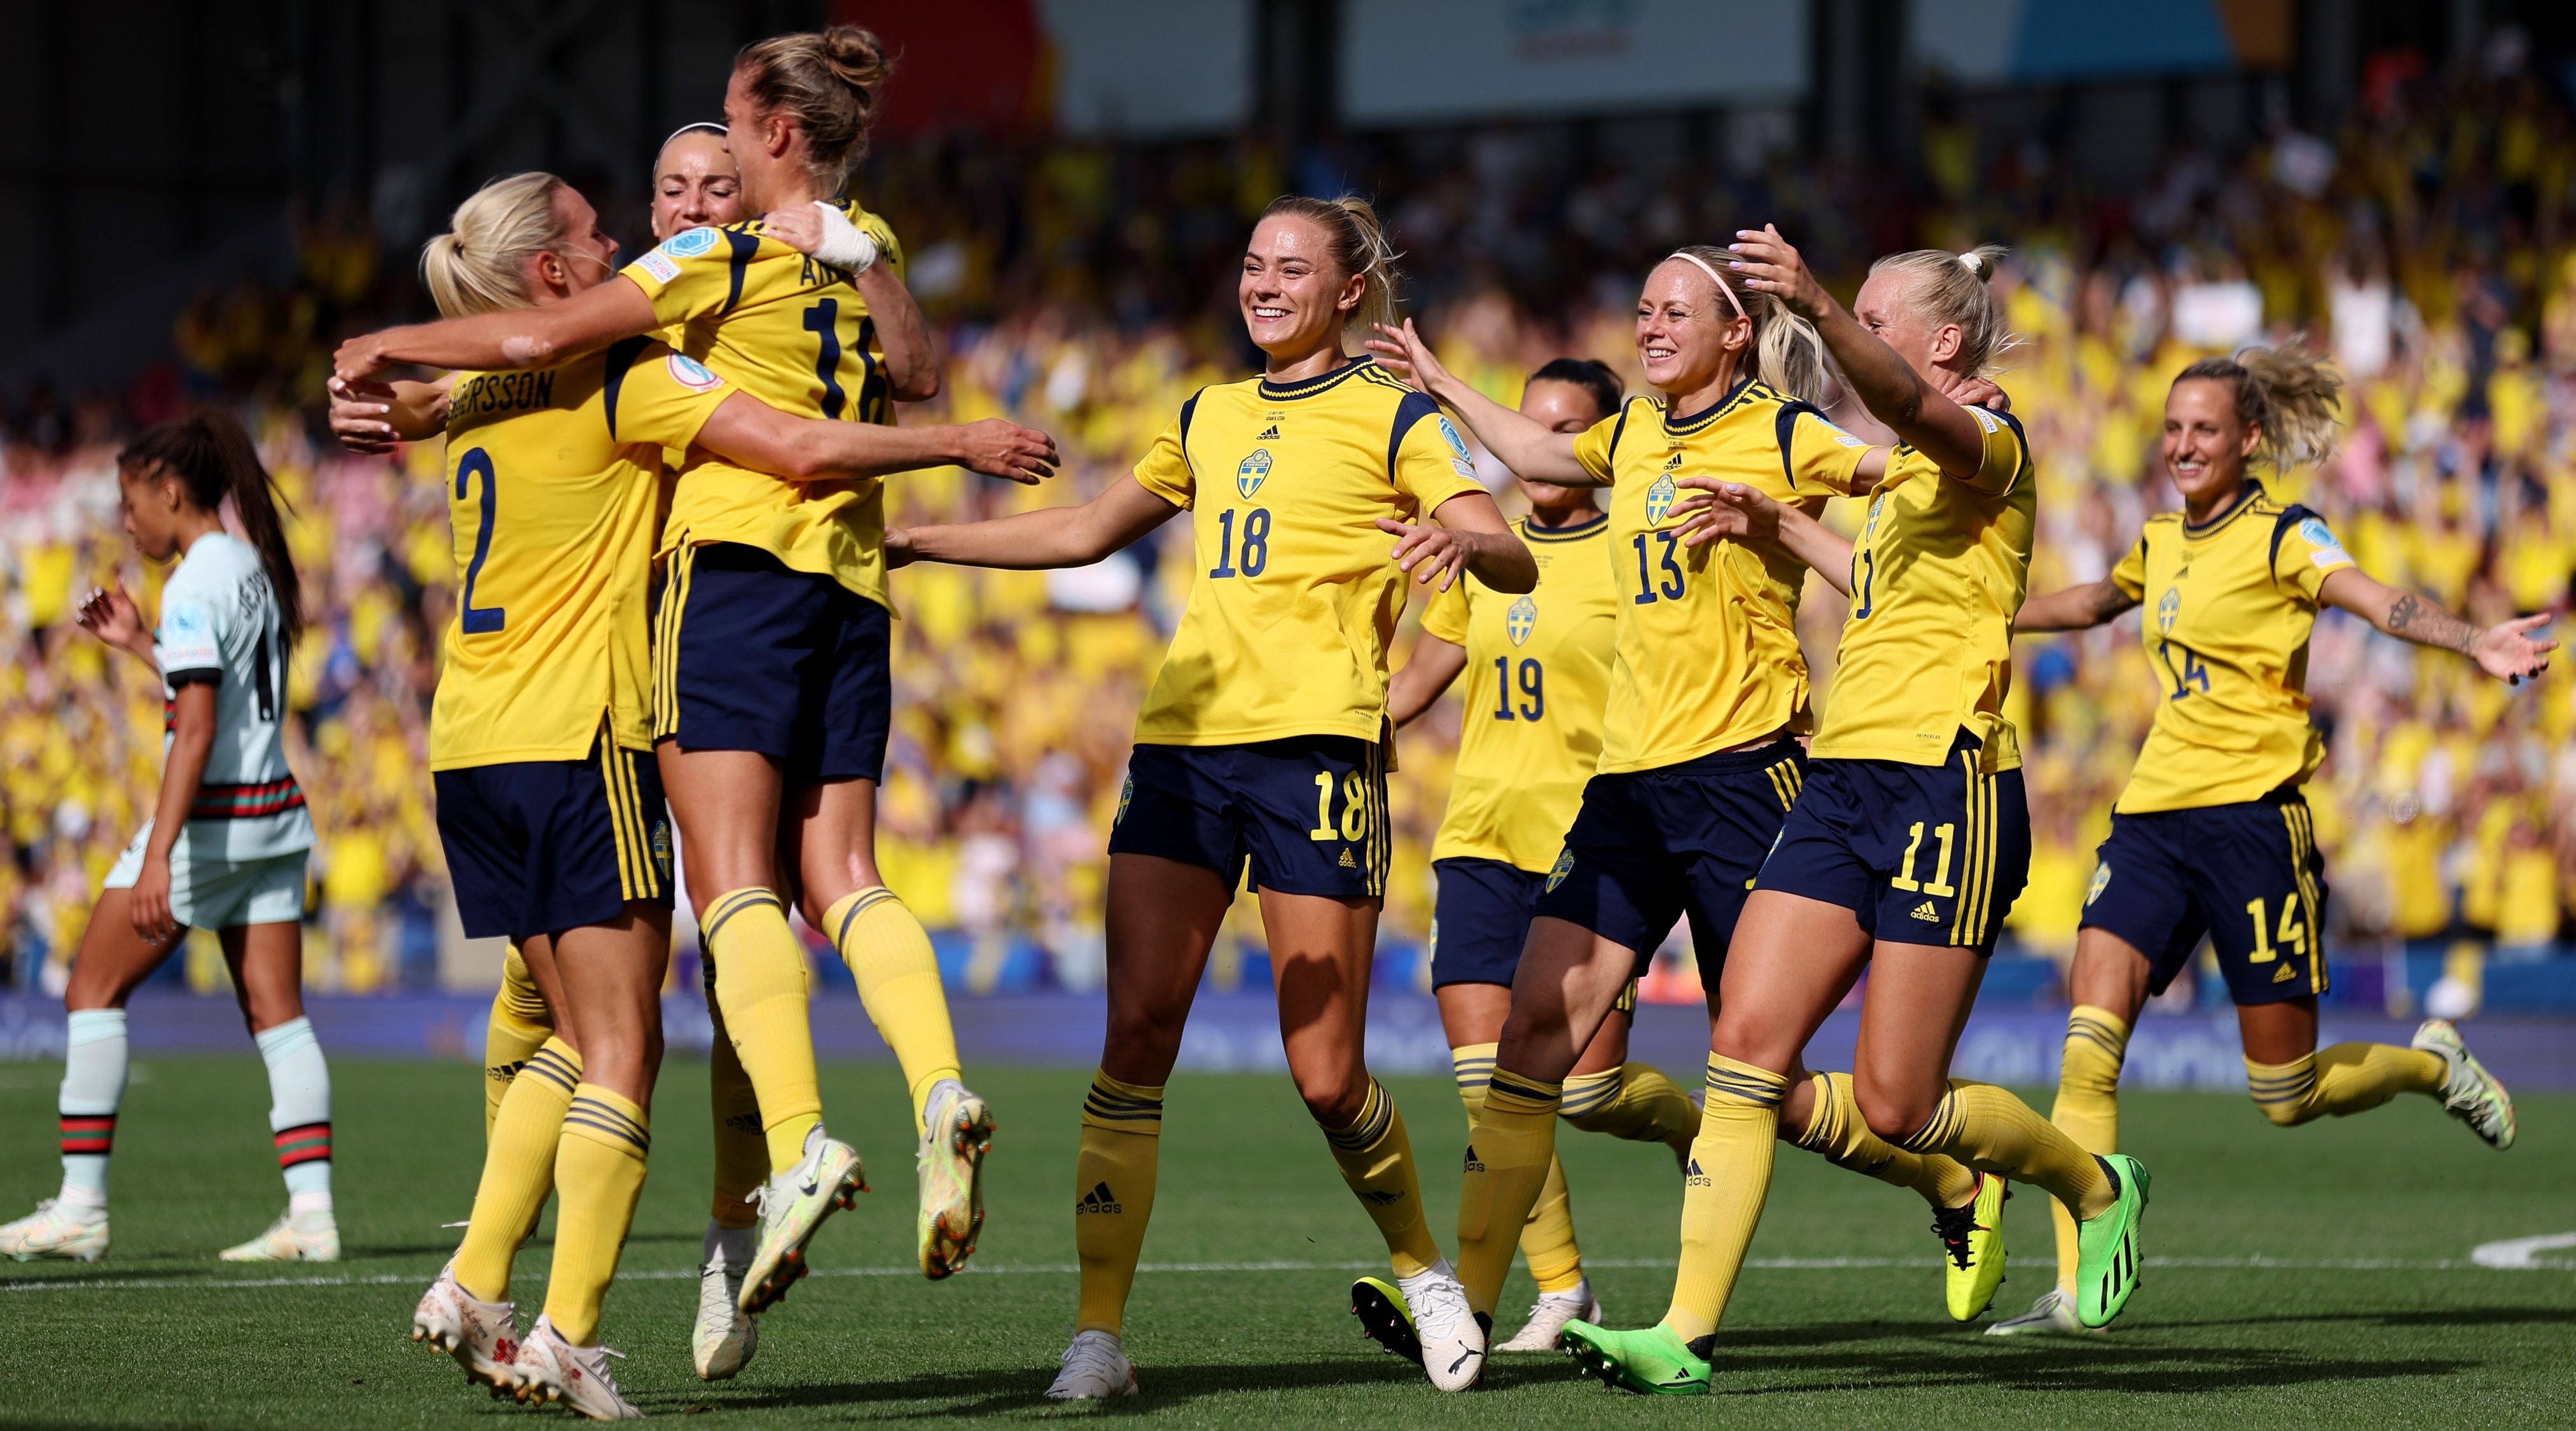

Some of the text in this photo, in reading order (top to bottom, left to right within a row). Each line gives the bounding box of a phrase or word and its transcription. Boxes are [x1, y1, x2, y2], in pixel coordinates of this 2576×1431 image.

[455, 447, 505, 634] 2
[1209, 508, 1271, 579] 18
[1633, 530, 1685, 605] 13
[1495, 656, 1544, 722] 19
[2158, 637, 2210, 702] 14
[1310, 770, 1366, 841] 18
[1338, 860, 1357, 868] adidas
[1892, 822, 1955, 897] 11
[1910, 911, 1939, 922] adidas
[2247, 892, 2306, 964] 14
[487, 1068, 515, 1084] adid
[726, 1118, 761, 1135] adid
[1687, 1177, 1711, 1187] das
